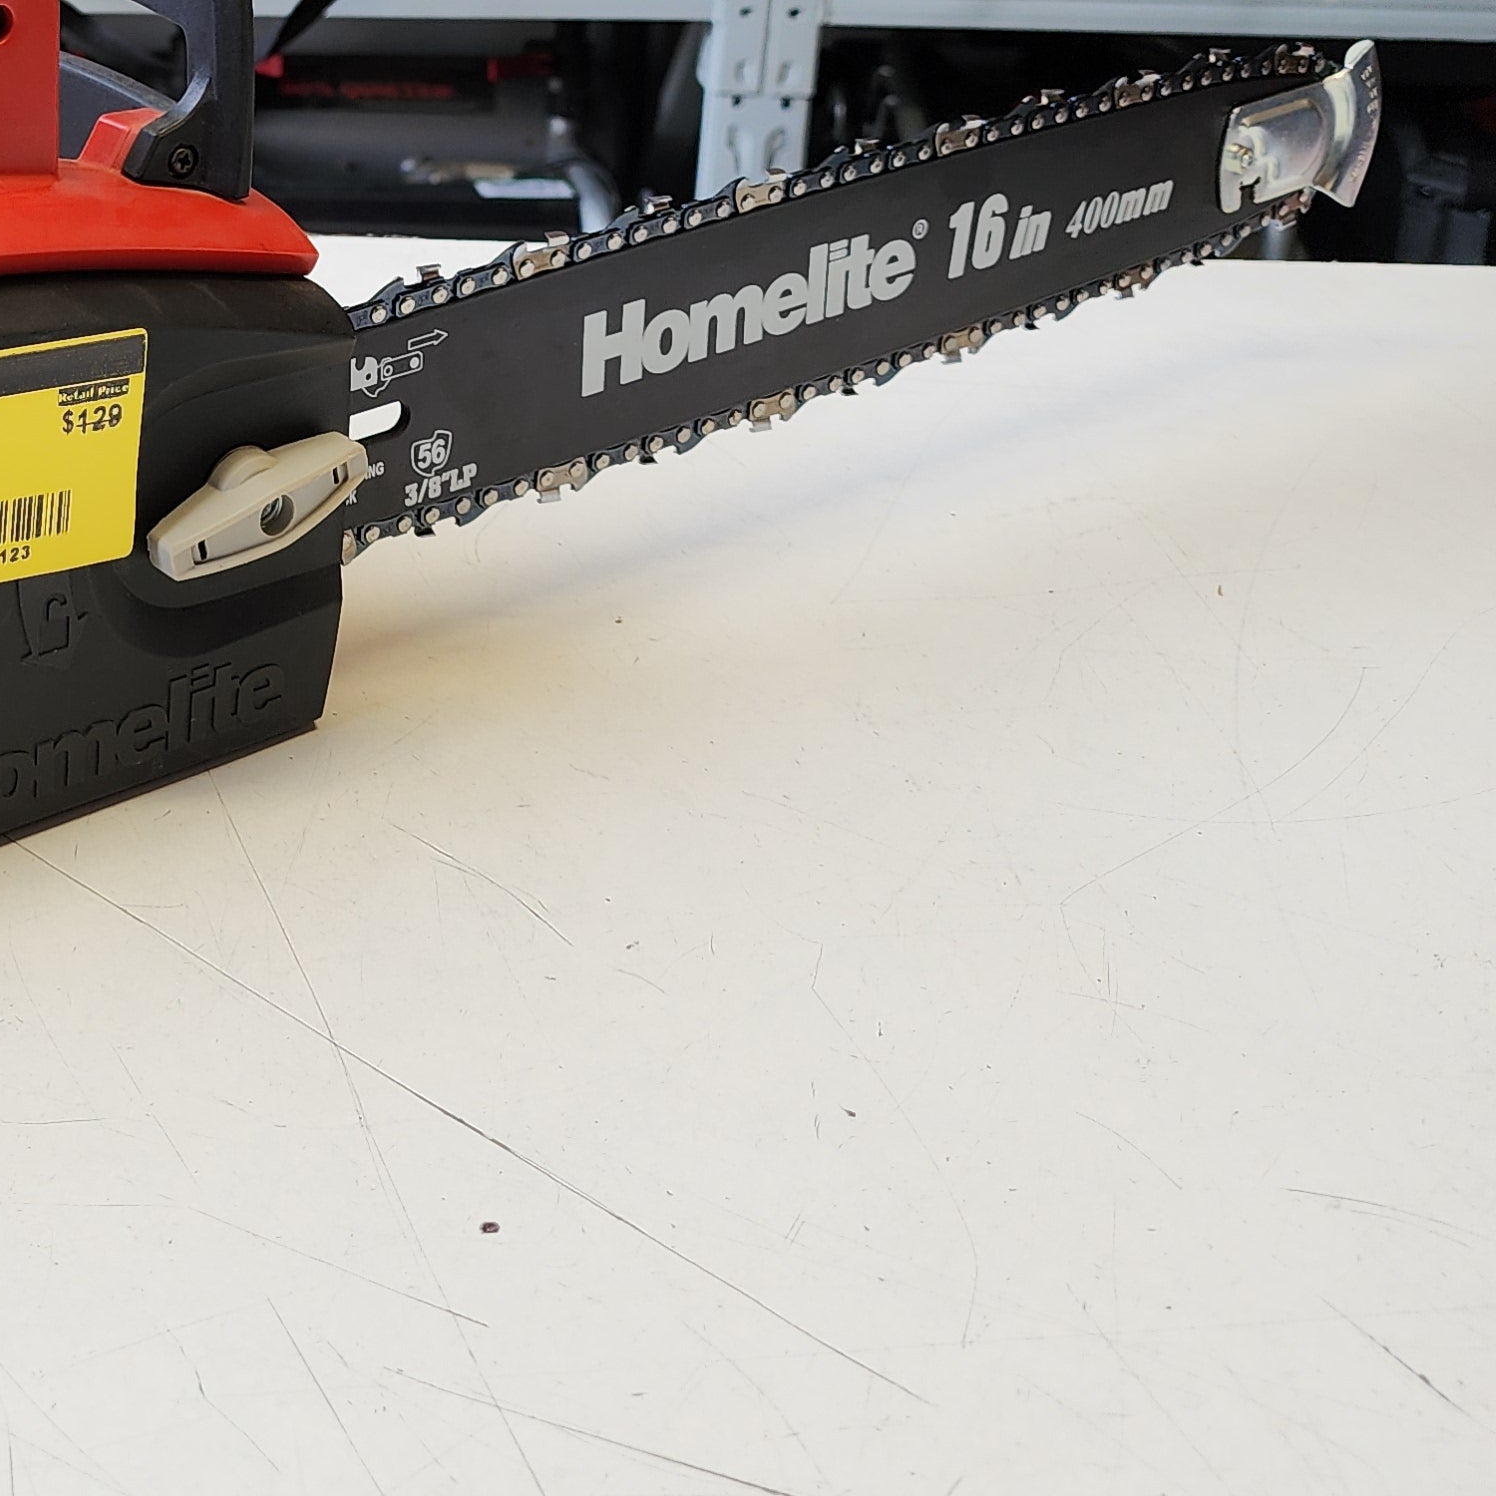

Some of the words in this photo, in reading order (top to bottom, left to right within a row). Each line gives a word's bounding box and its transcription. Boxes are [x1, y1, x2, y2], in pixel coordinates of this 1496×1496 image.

[948, 193, 1009, 279] 16
[1008, 204, 1052, 261] in
[1065, 179, 1175, 240] 400mm
[58, 385, 95, 404] Retail
[97, 383, 130, 397] Price
[417, 438, 446, 469] 56
